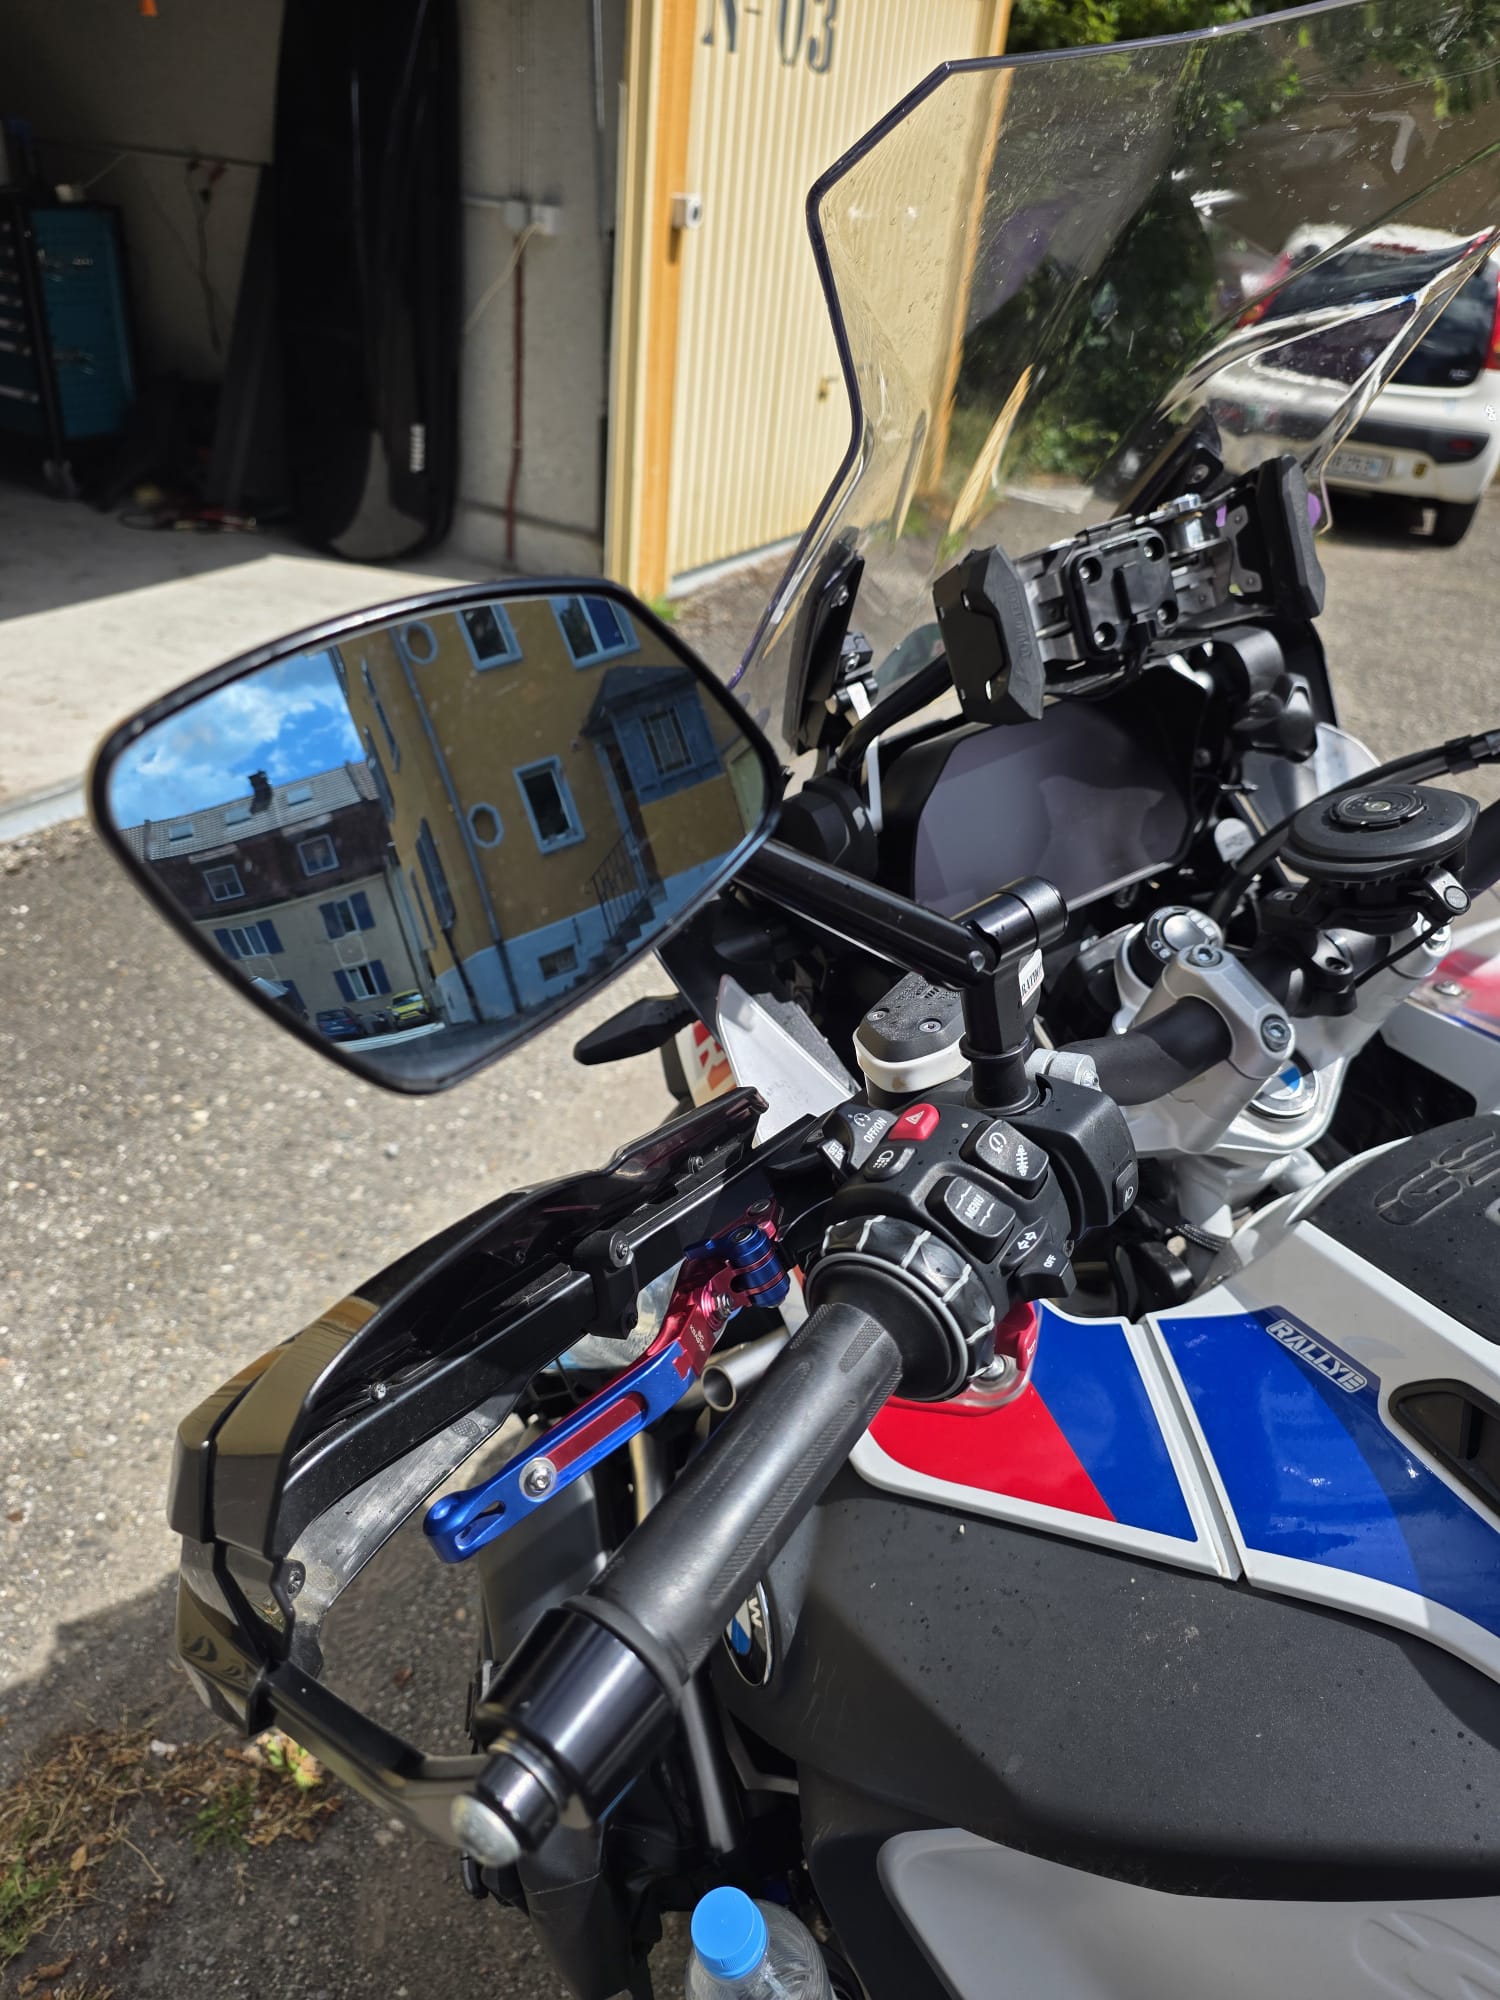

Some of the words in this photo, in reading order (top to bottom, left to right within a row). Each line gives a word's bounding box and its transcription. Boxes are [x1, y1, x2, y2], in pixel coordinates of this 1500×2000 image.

[863, 1116, 887, 1143] OFF/ON
[964, 1193, 985, 1220] MENU
[1043, 1254, 1056, 1268] OFF
[1268, 1321, 1366, 1391] RALLYE
